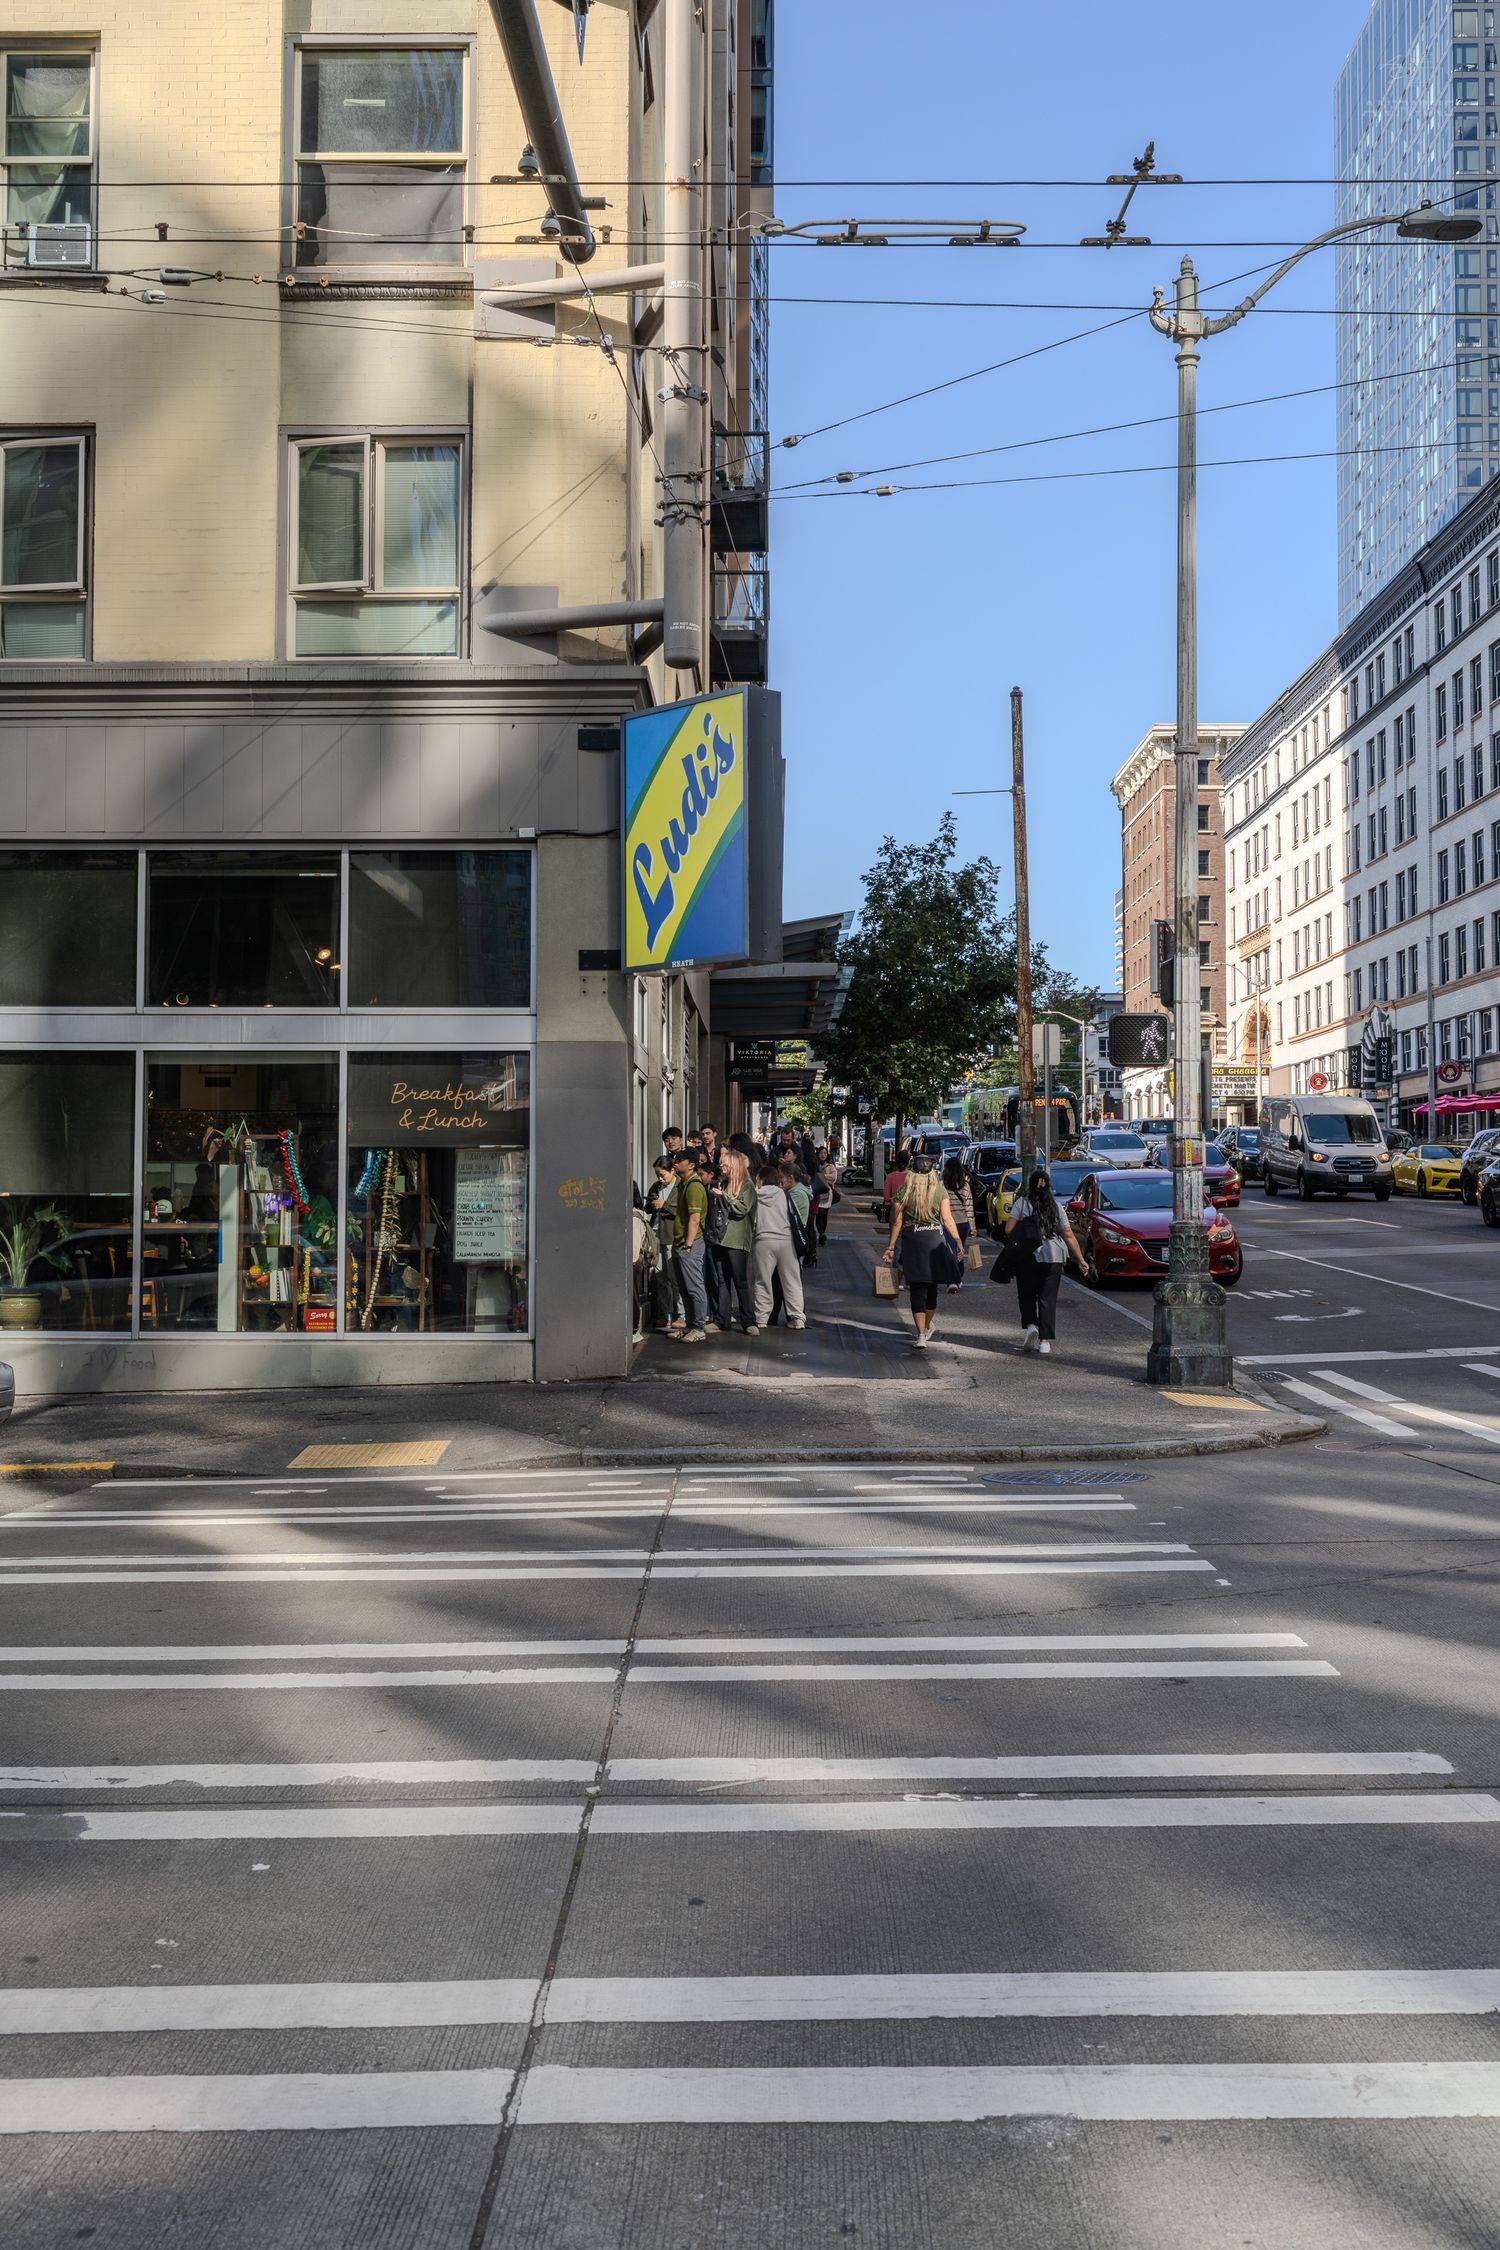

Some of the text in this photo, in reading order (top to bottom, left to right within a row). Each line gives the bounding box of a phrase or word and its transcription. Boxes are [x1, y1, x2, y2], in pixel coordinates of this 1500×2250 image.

[633, 712, 735, 955] Ludi's
[671, 958, 695, 968] HEATH
[391, 1082, 504, 1110] Breakfast
[399, 1108, 488, 1131] & Lunch
[309, 1312, 328, 1320] Sorry
[123, 1348, 157, 1371] Food
